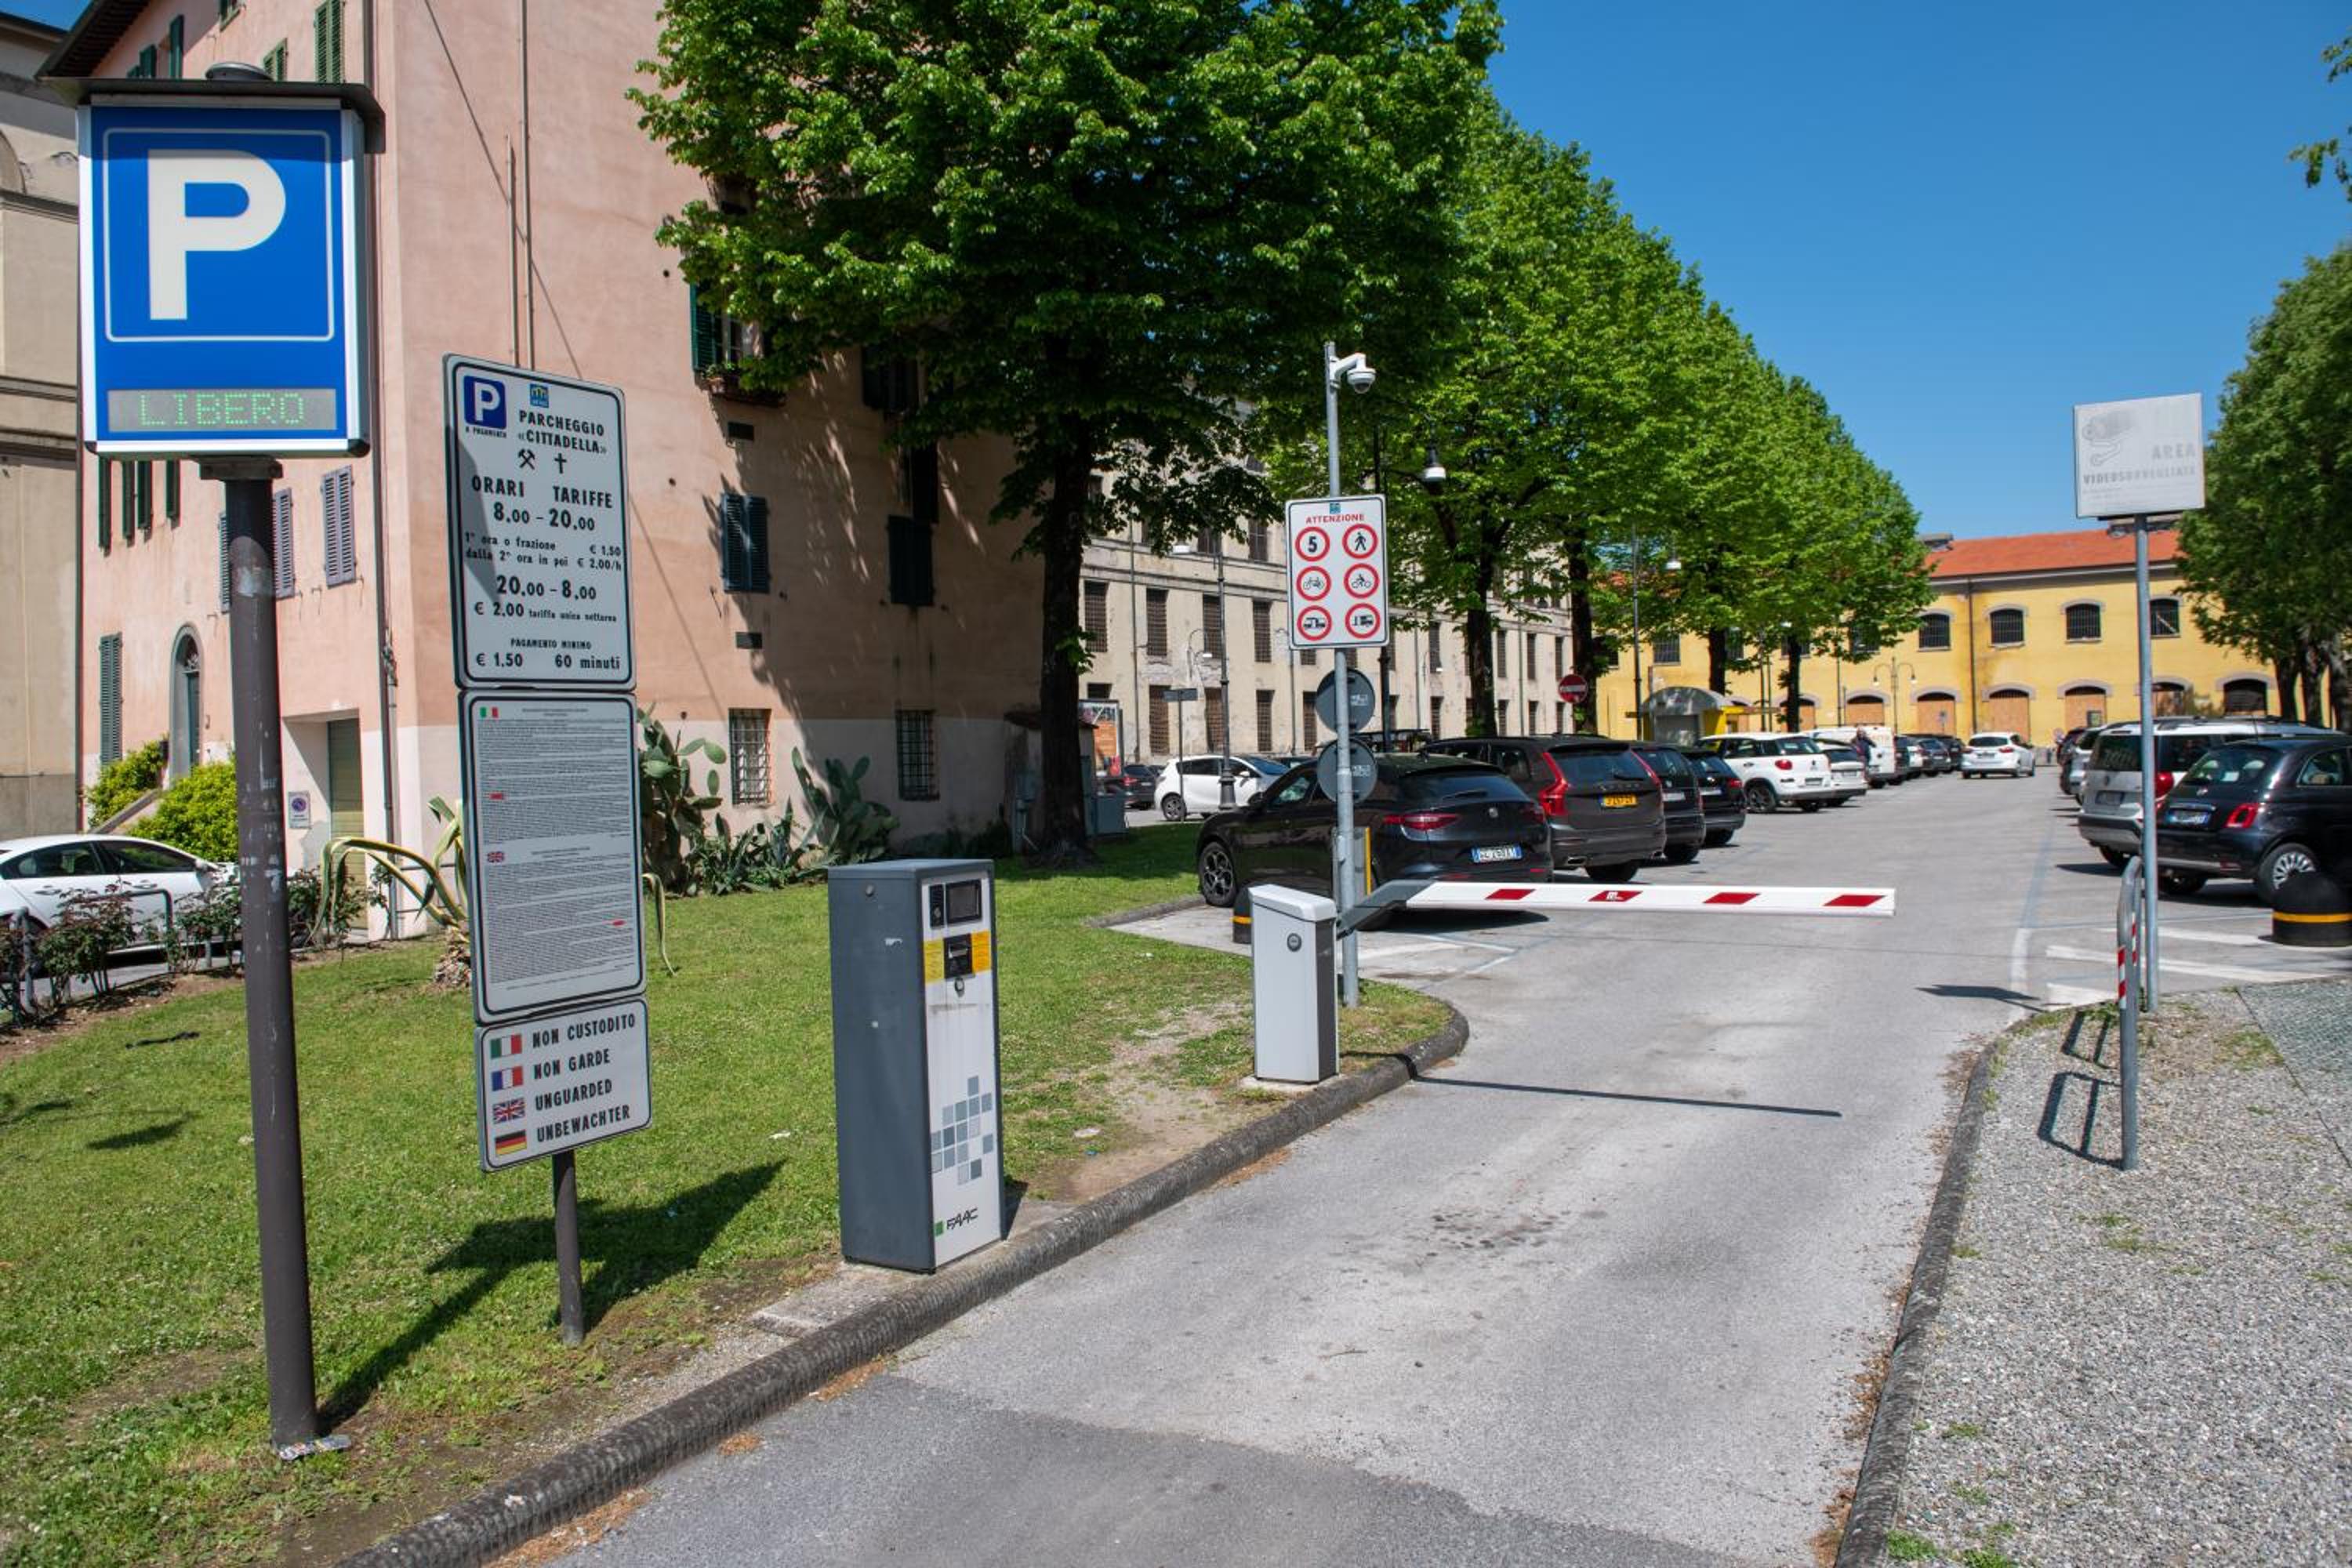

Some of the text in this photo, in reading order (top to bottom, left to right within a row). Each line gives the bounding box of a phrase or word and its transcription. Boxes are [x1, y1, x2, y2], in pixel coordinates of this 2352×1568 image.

[147, 149, 286, 321] P
[140, 392, 304, 426] LIBERO
[474, 382, 500, 422] P
[519, 410, 604, 437] PARCHEGGIO
[472, 474, 613, 509] ORARI TARIFFE
[493, 502, 530, 524] 8.00
[549, 508, 595, 531] 20.00
[1305, 514, 1365, 524] ATTENZIONE
[481, 535, 498, 545] ora
[516, 535, 556, 550] frazione
[590, 544, 596, 554] €
[601, 545, 621, 557] 1.50
[1308, 535, 1318, 553] 5
[466, 547, 493, 561] dalla
[517, 554, 532, 563] ora
[539, 554, 548, 564] in
[554, 556, 568, 568] poi
[577, 557, 584, 568] €
[590, 557, 621, 572] 2.00/h
[496, 575, 545, 597] 20.00
[562, 579, 597, 600] 8.00
[474, 601, 484, 615] €
[493, 602, 524, 617] 2.00
[529, 608, 555, 619] tariffa
[510, 637, 592, 650] PAGAMENTO MINIMO
[476, 652, 620, 670] € 1.50 60 minuti
[532, 1013, 636, 1048] NON CUSTODITO
[533, 1048, 611, 1080] NON GARDE
[535, 1078, 612, 1111] UNGUARDED
[537, 1104, 630, 1142] UNBEWACHTER
[947, 1207, 978, 1230] FAAC
